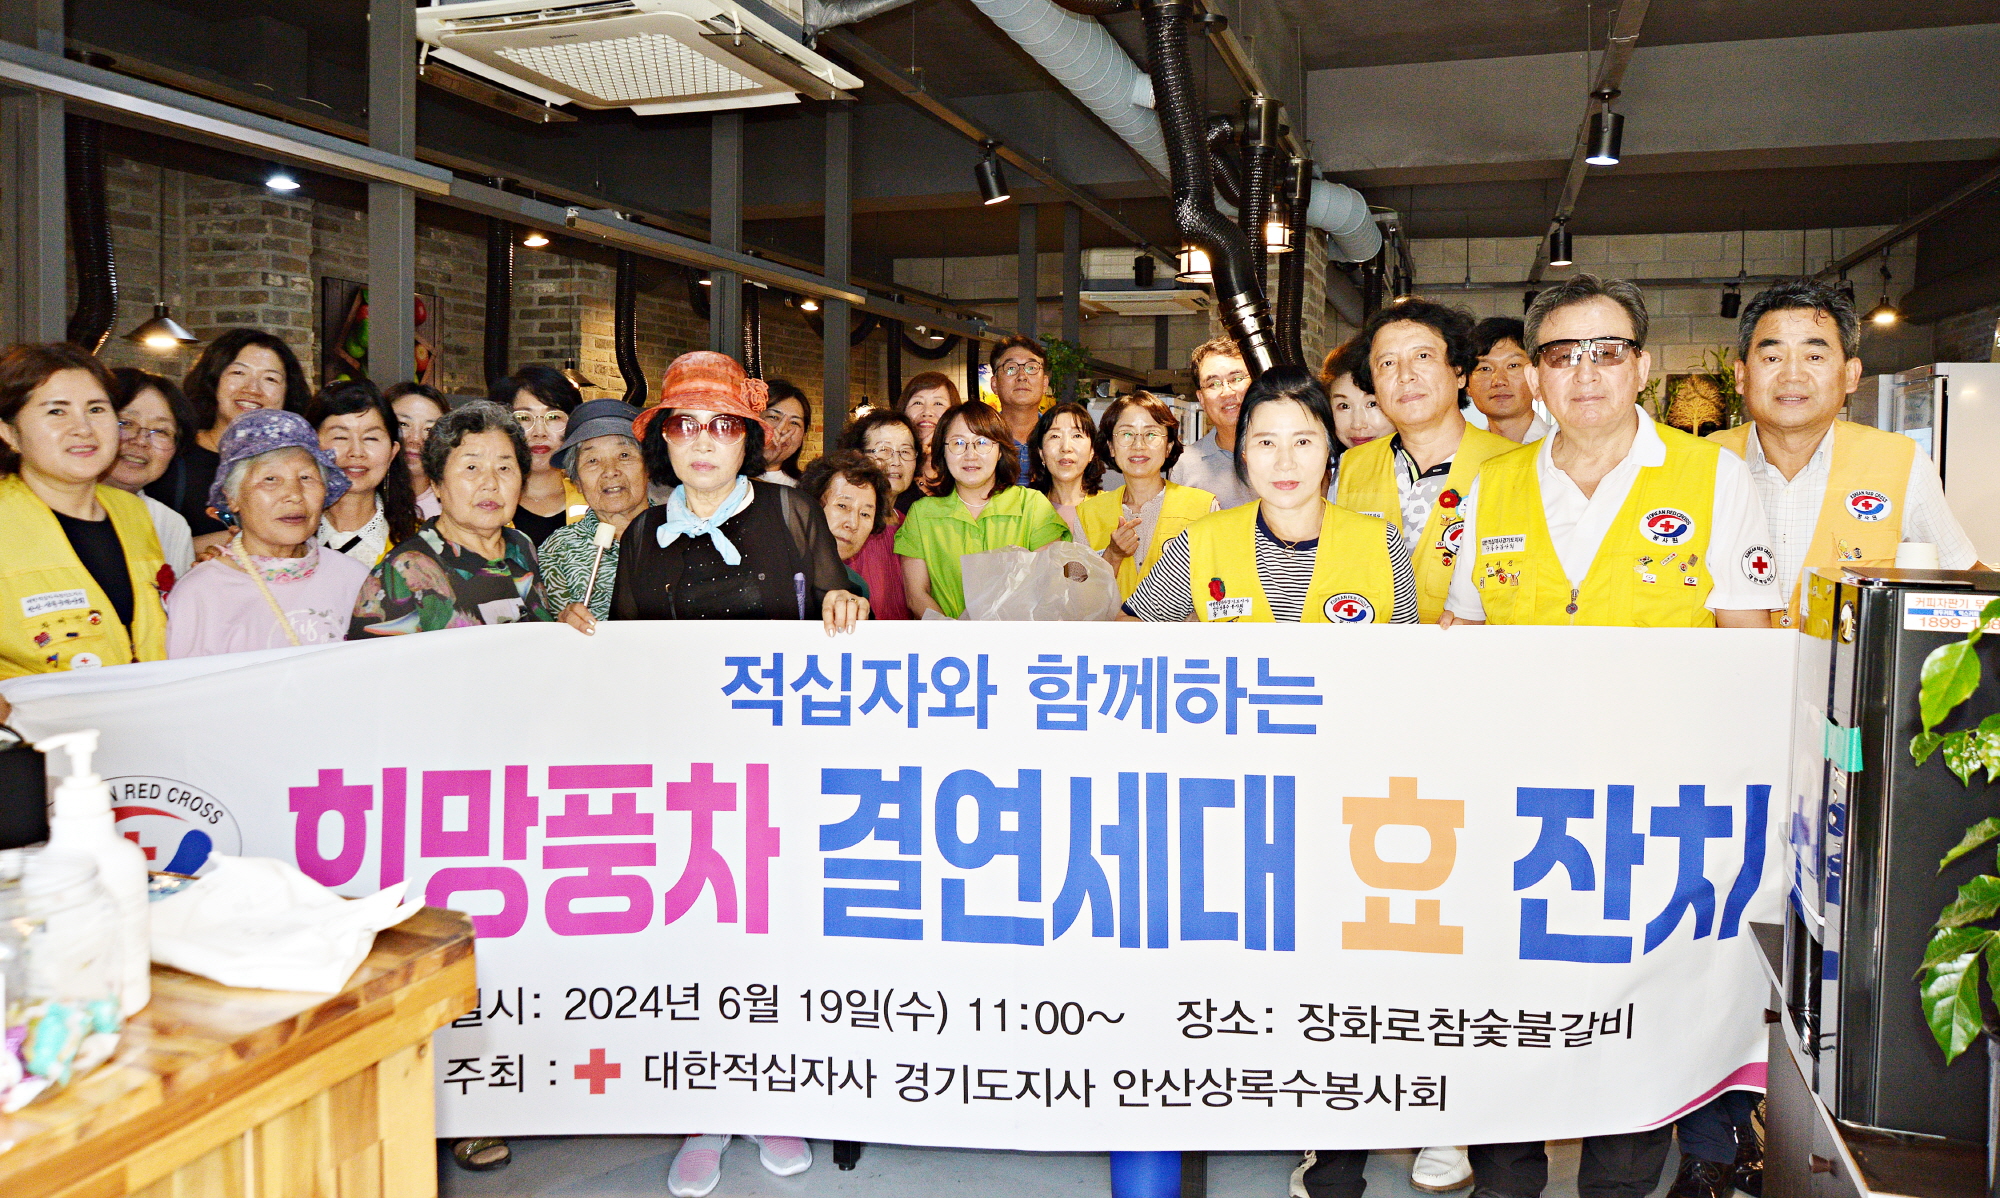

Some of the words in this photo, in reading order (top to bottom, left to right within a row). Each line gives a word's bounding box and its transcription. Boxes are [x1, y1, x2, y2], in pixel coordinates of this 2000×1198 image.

[1914, 596, 1969, 609] 커피자판기
[721, 652, 998, 730] 적십자와
[1027, 654, 1324, 735] 함께하는
[125, 783, 162, 800] RED
[166, 786, 224, 825] CROSS
[819, 765, 1296, 952] 결연세대
[1341, 776, 1465, 955] 효
[1513, 784, 1772, 964] 잔치
[564, 982, 701, 1022] 2024년
[718, 983, 779, 1024] 6월
[800, 988, 948, 1035] 19일(수)
[1176, 998, 1273, 1039] 장소:
[1297, 1002, 1635, 1049] 장화로참숯불갈비
[443, 1053, 525, 1096] 주최
[645, 1050, 878, 1099] 대한적십자사
[895, 1062, 1096, 1109] 경기도지사
[1113, 1067, 1447, 1112] 안산상록수봉사회
